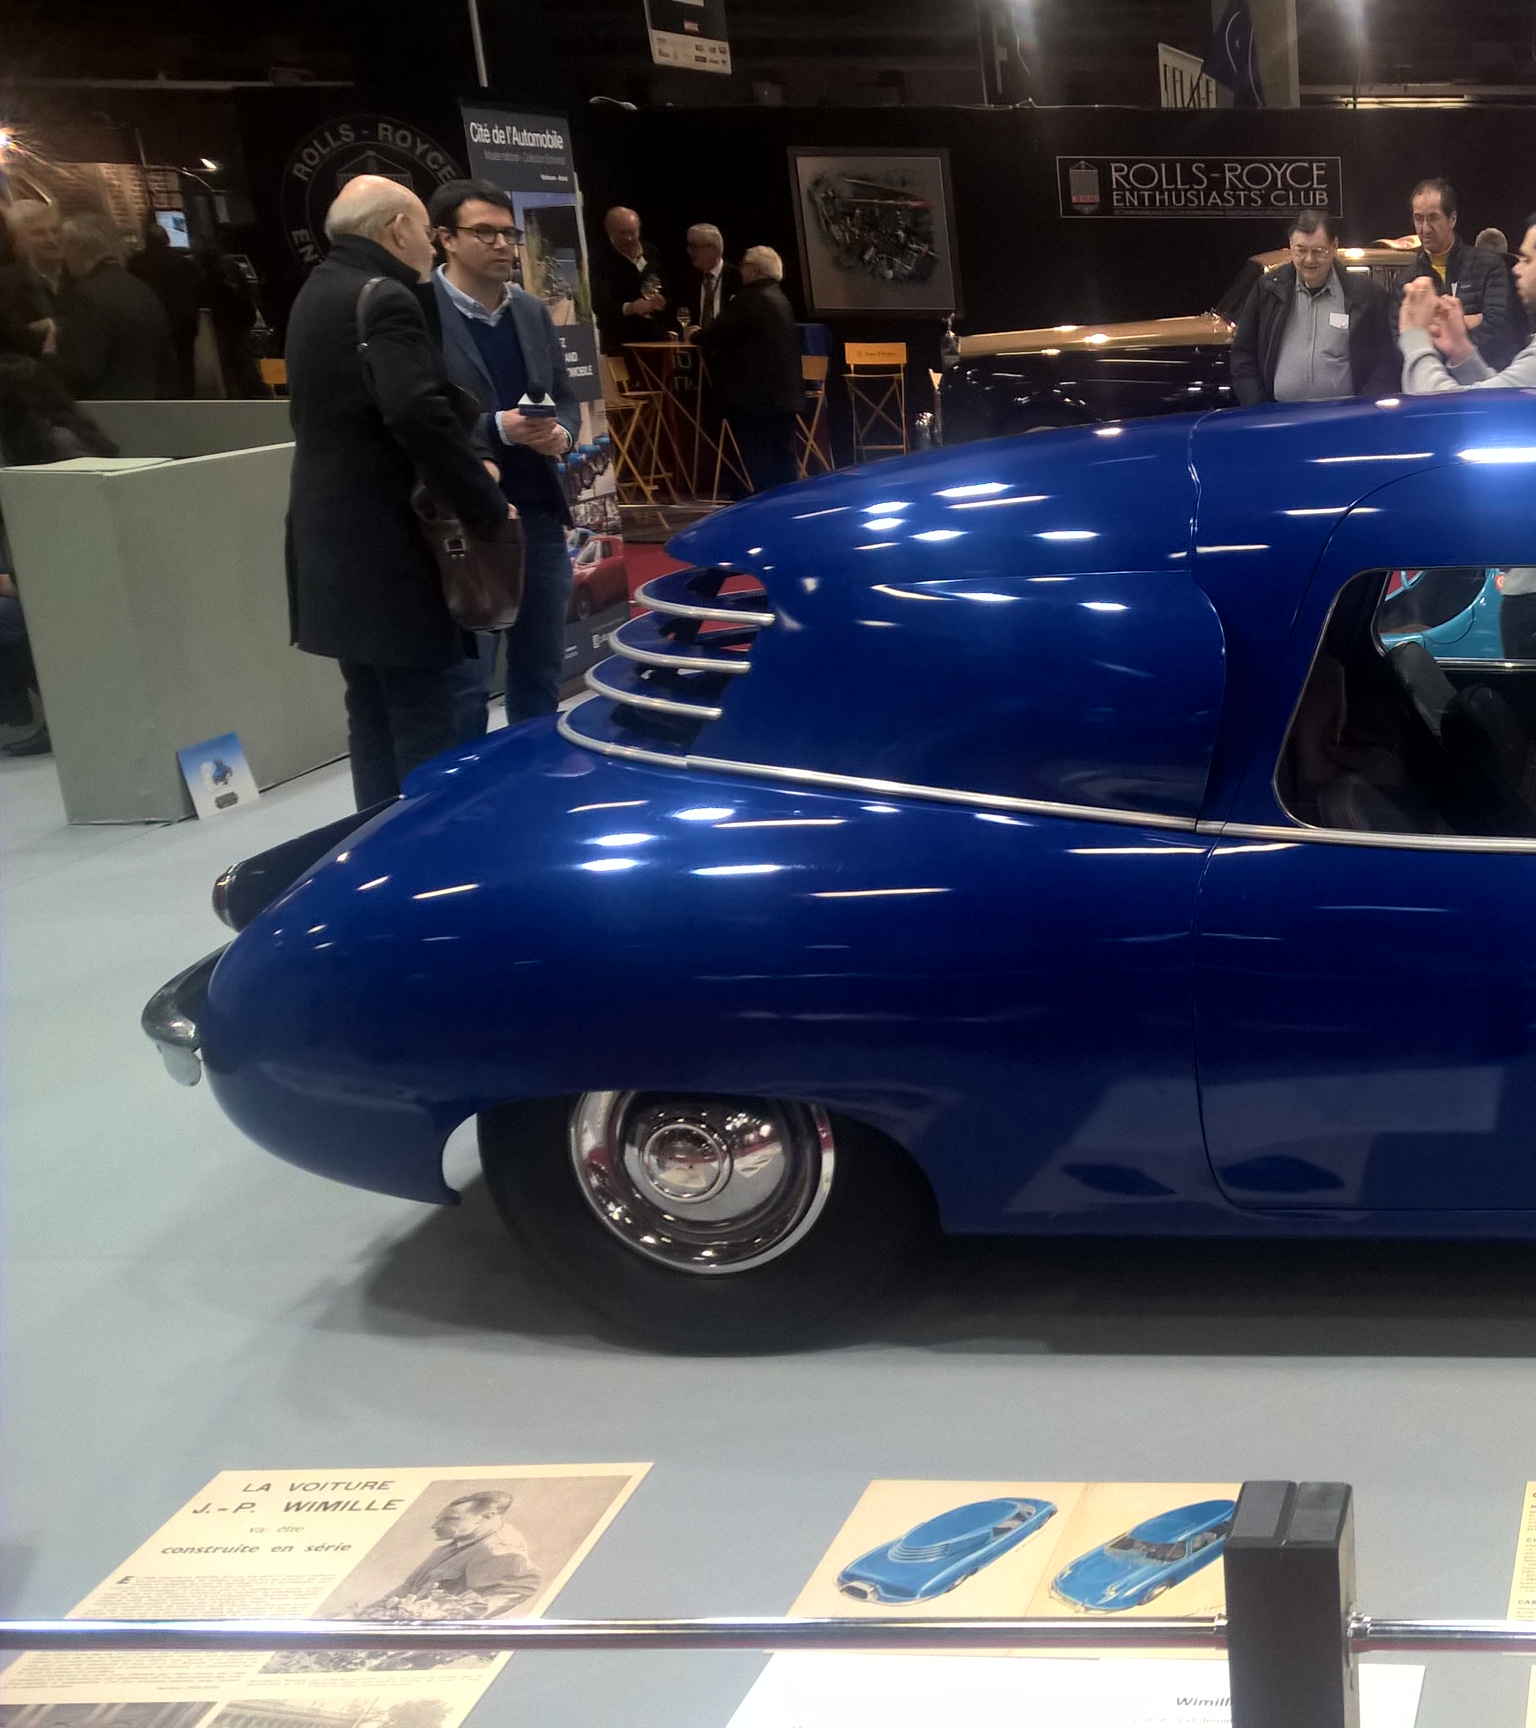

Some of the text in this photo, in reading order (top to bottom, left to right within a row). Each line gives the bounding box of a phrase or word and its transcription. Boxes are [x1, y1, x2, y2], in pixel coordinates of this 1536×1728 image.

[470, 121, 564, 150] Cité de l'Automobile
[293, 123, 355, 183] ROLLS
[377, 123, 456, 185] ROYCE
[1110, 162, 1329, 190] ROLLS-ROYCE
[1112, 190, 1329, 207] ENTHUSIASTS' CLUB
[242, 1480, 396, 1493] LA VOITURE
[283, 1499, 405, 1513] WIMILLE
[160, 1542, 352, 1555] construite en série
[1176, 1697, 1232, 1707] Wimill
